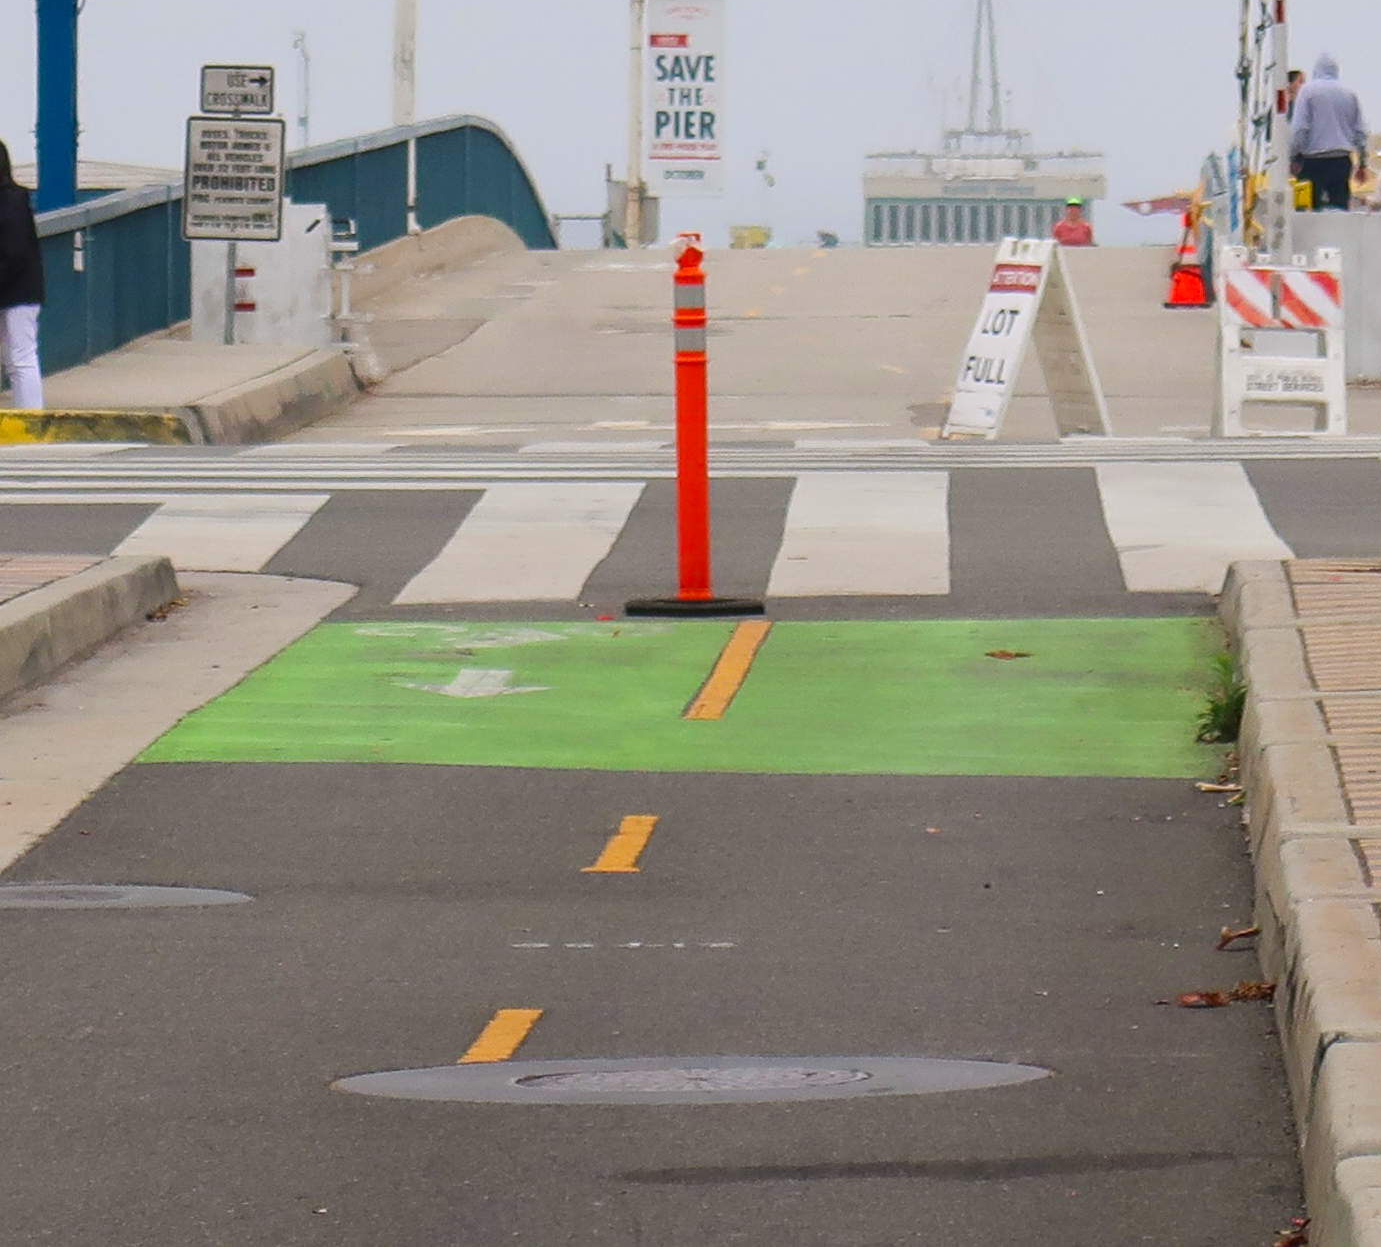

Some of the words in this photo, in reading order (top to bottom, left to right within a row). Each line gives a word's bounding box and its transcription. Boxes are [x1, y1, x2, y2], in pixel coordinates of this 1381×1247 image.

[655, 55, 715, 82] SAVE
[227, 74, 247, 88] USE
[207, 92, 268, 107] CROSSWALK
[668, 88, 704, 106] THE
[655, 111, 716, 139] PIER
[191, 175, 276, 192] PROHIBITED
[981, 309, 1021, 336] LOT
[961, 356, 1006, 384] FULL
